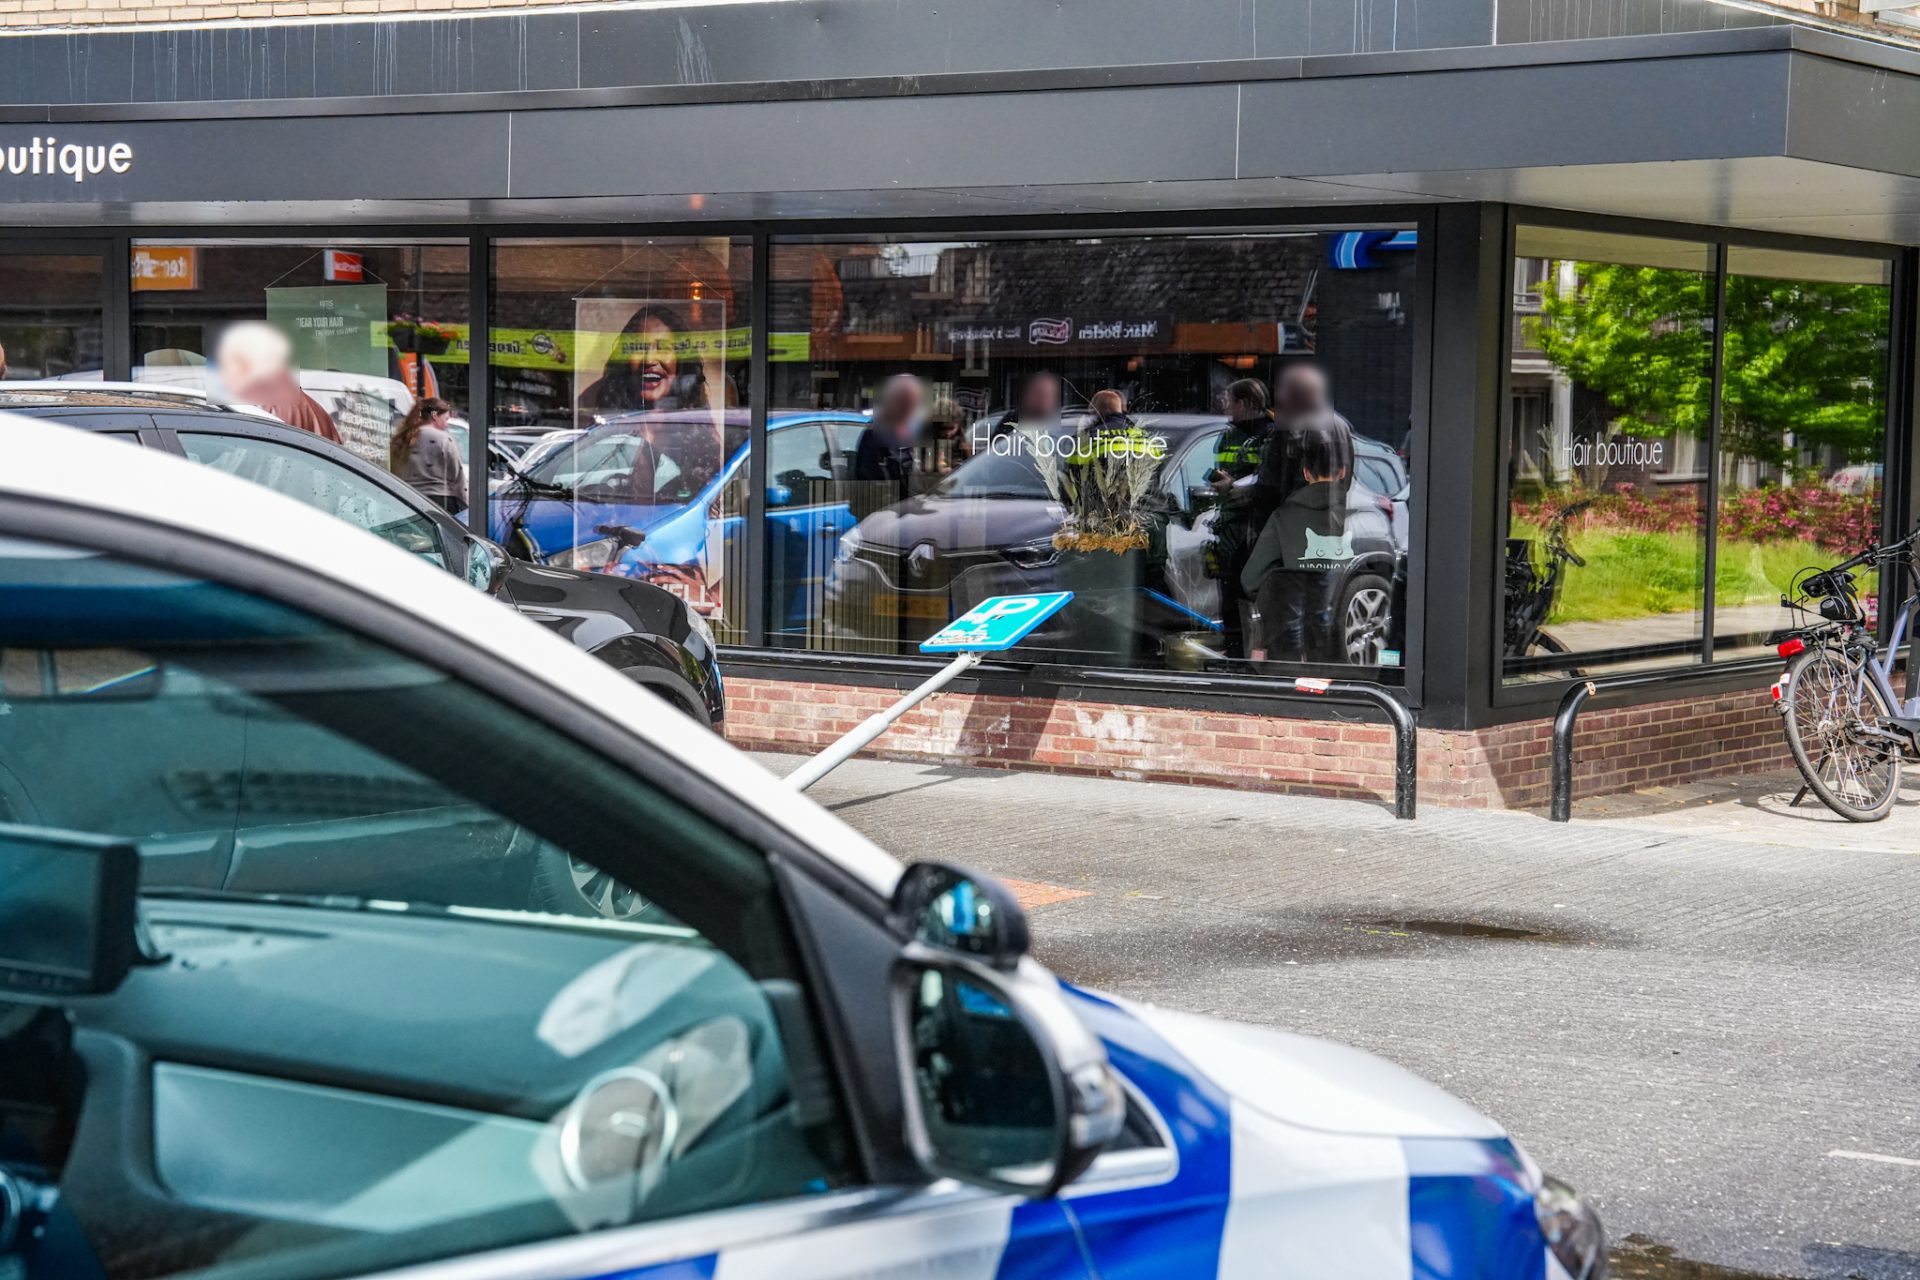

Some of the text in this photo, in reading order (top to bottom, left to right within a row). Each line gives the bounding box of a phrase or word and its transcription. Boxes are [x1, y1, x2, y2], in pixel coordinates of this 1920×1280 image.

[0, 136, 132, 182] utique
[329, 316, 344, 327] HAIR
[972, 423, 1168, 466] Hair boutique
[1561, 431, 1663, 471] Hair boutique
